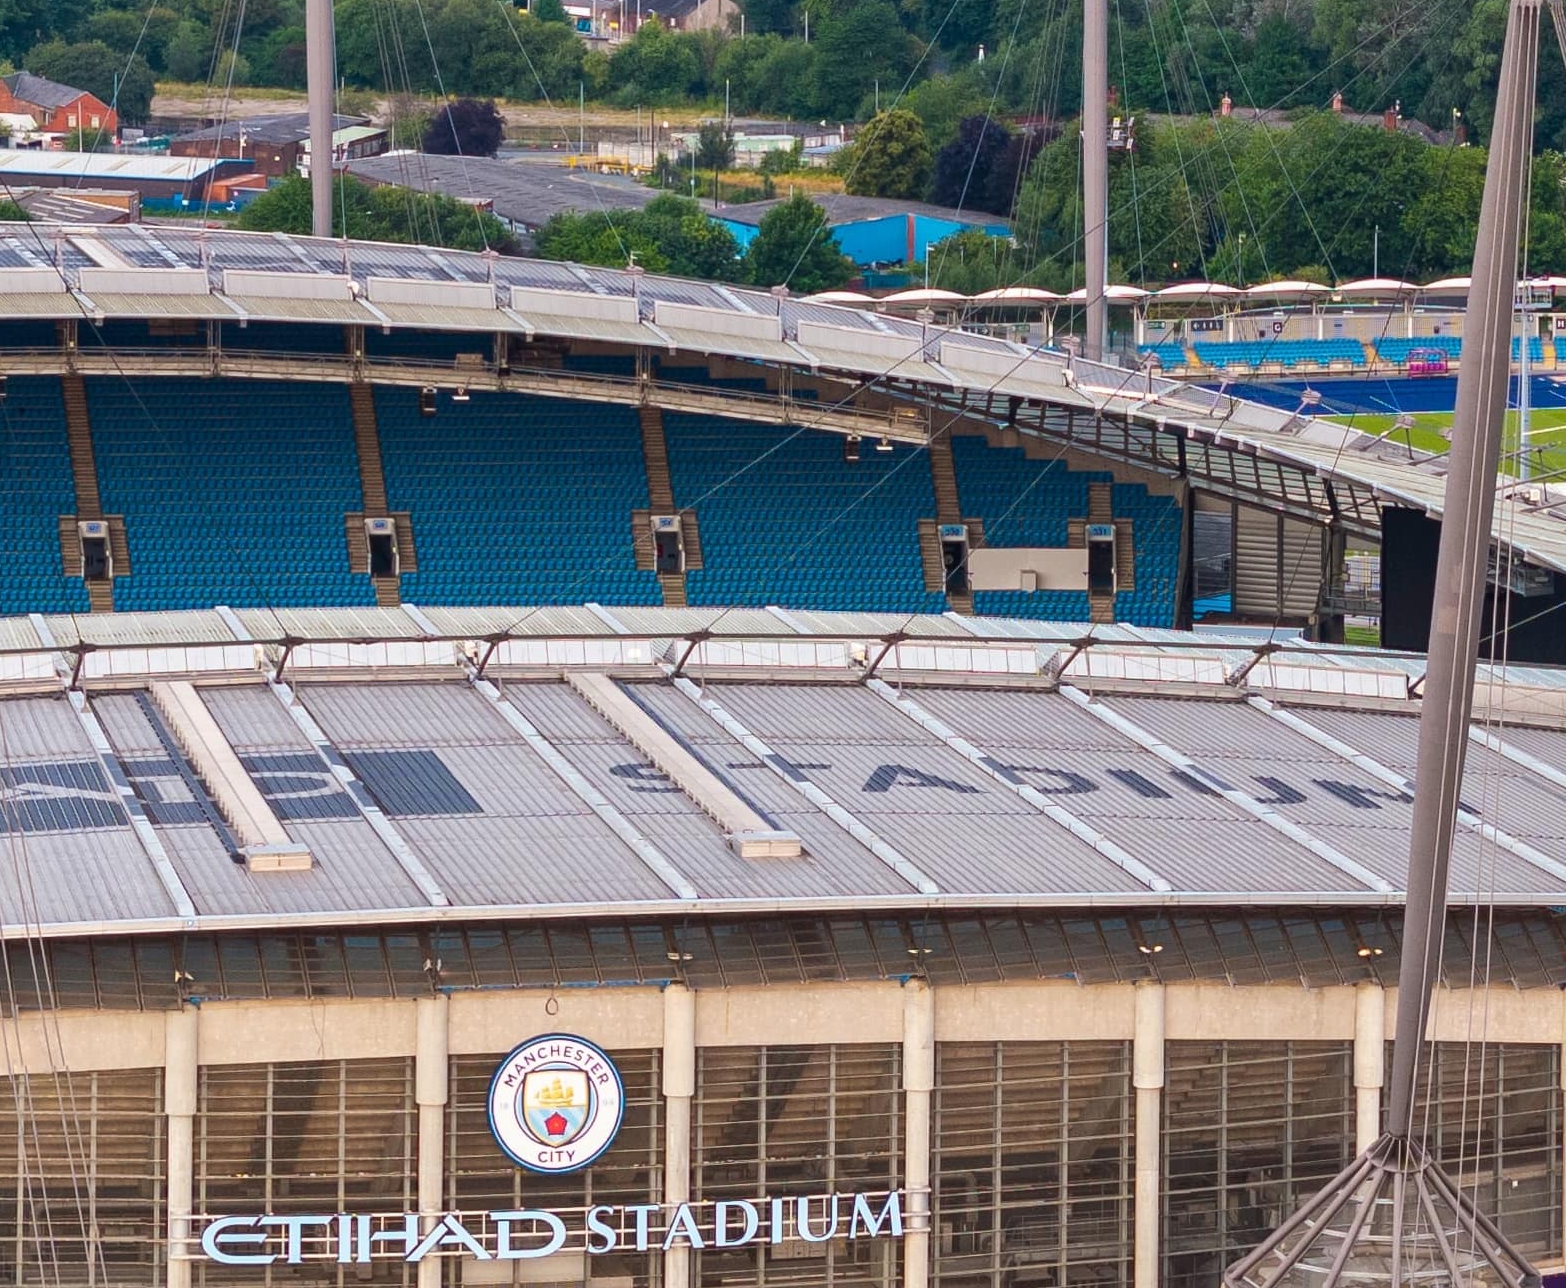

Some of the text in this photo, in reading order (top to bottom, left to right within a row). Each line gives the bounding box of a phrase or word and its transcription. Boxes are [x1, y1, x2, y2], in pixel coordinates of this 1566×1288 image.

[502, 1042, 610, 1089] MANCHESTER
[537, 1148, 577, 1165] CITY
[200, 1189, 904, 1265] ETIHAD STADIUM
